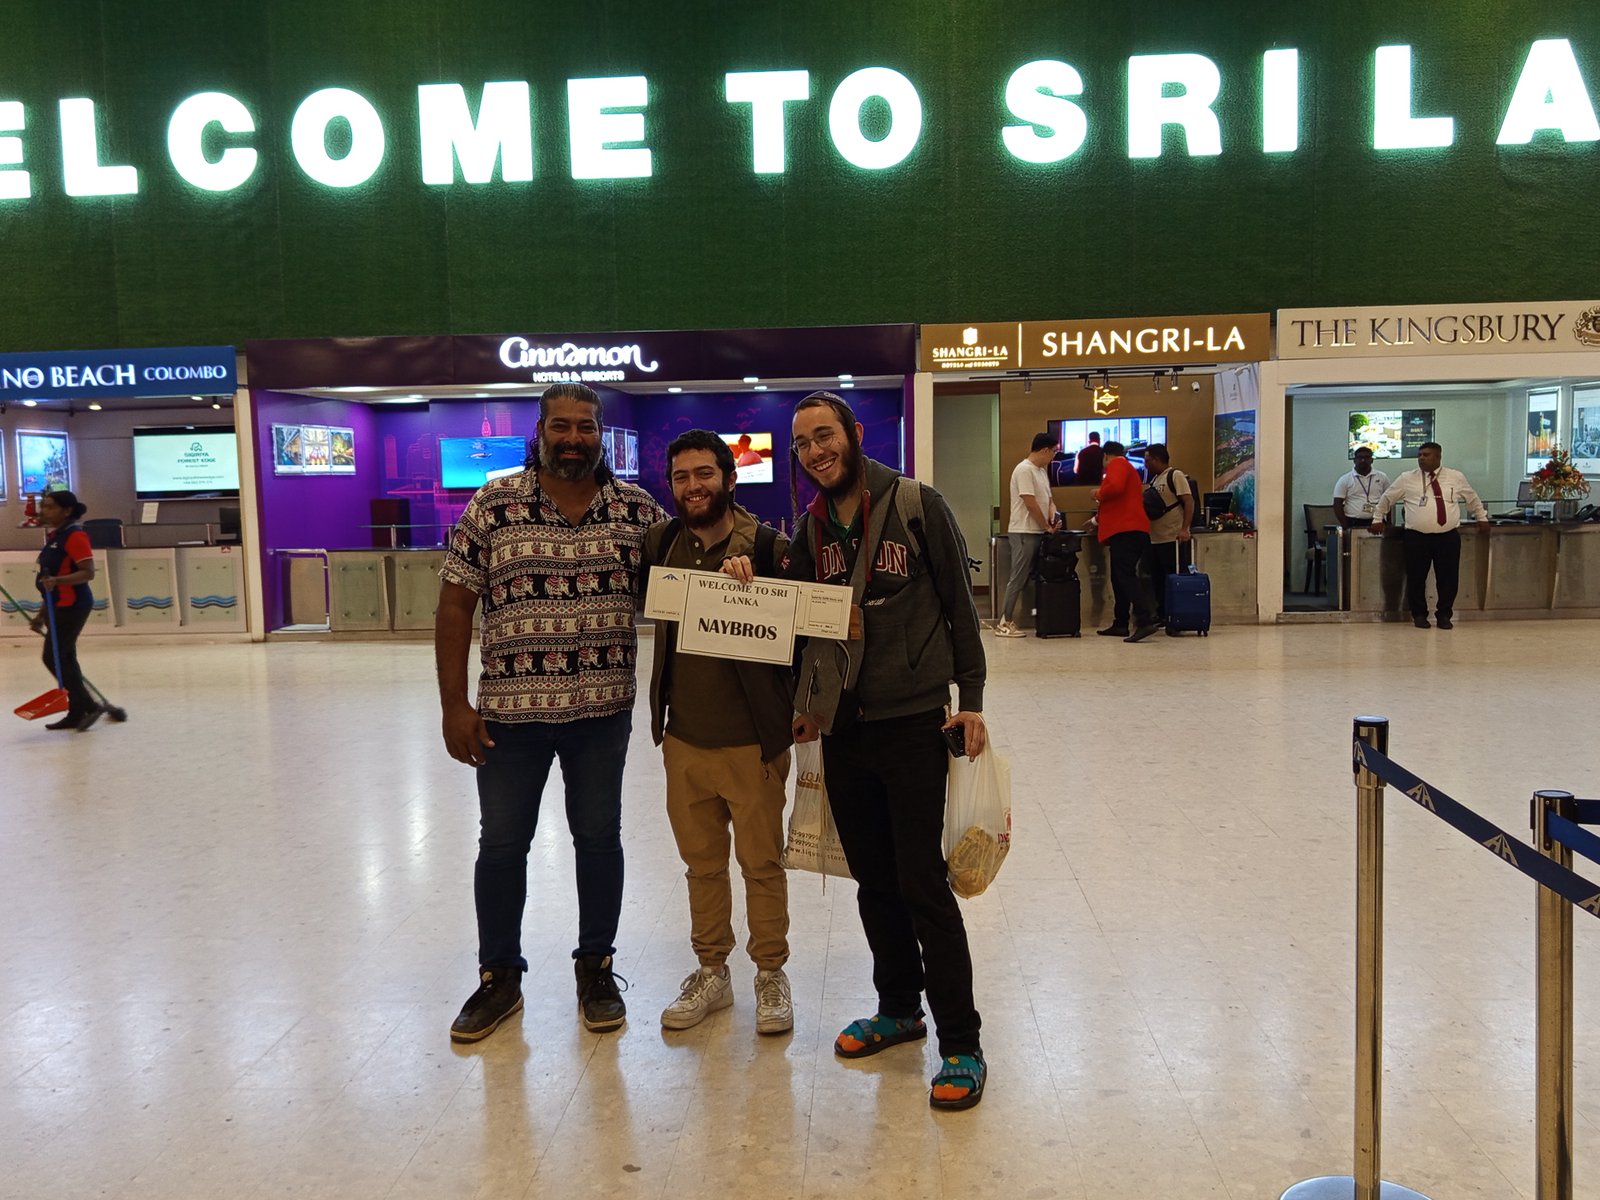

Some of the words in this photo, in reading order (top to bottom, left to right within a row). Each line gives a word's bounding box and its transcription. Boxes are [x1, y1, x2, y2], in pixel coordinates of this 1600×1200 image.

[725, 67, 922, 170] TO
[1002, 47, 1298, 164] SRI
[1373, 38, 1600, 150] LA
[1042, 326, 1246, 358] SHANGRI-LA
[1291, 317, 1357, 348] THE
[1368, 312, 1566, 346] KINGSBURY
[499, 336, 659, 373] Cinnamon
[932, 345, 1009, 359] SHANGRI-LA
[0, 367, 44, 389] NO
[50, 364, 136, 388] BEACH
[143, 365, 227, 381] COLOMBO
[532, 371, 570, 382] HOTELS
[699, 580, 752, 594] WELCOME
[754, 586, 769, 596] TO
[771, 588, 788, 598] SRI
[723, 595, 759, 607] LANKA
[698, 617, 778, 641] NAYBROS
